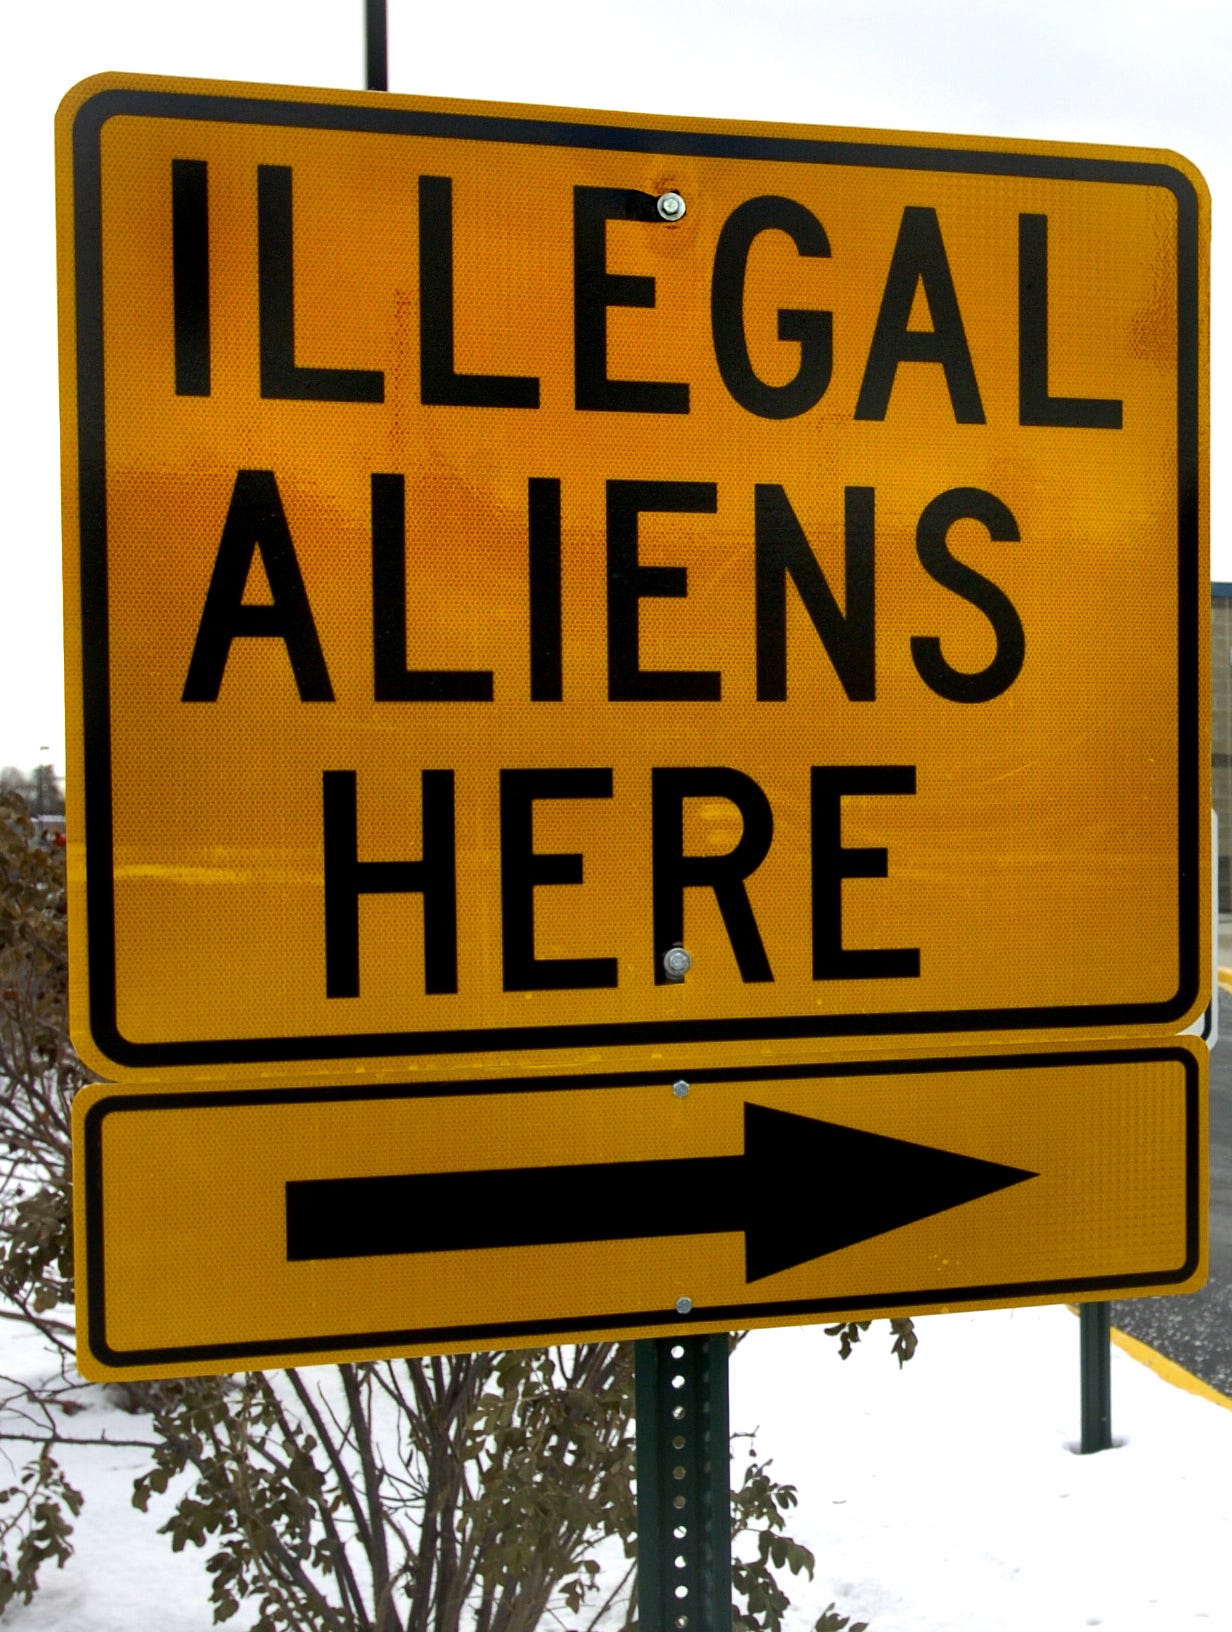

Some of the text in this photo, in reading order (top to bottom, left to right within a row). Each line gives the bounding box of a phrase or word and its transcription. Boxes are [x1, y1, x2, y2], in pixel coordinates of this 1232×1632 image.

[171, 159, 1123, 429] ILLEGAL
[181, 470, 1026, 704] ALIENS
[322, 765, 920, 999] HERE
